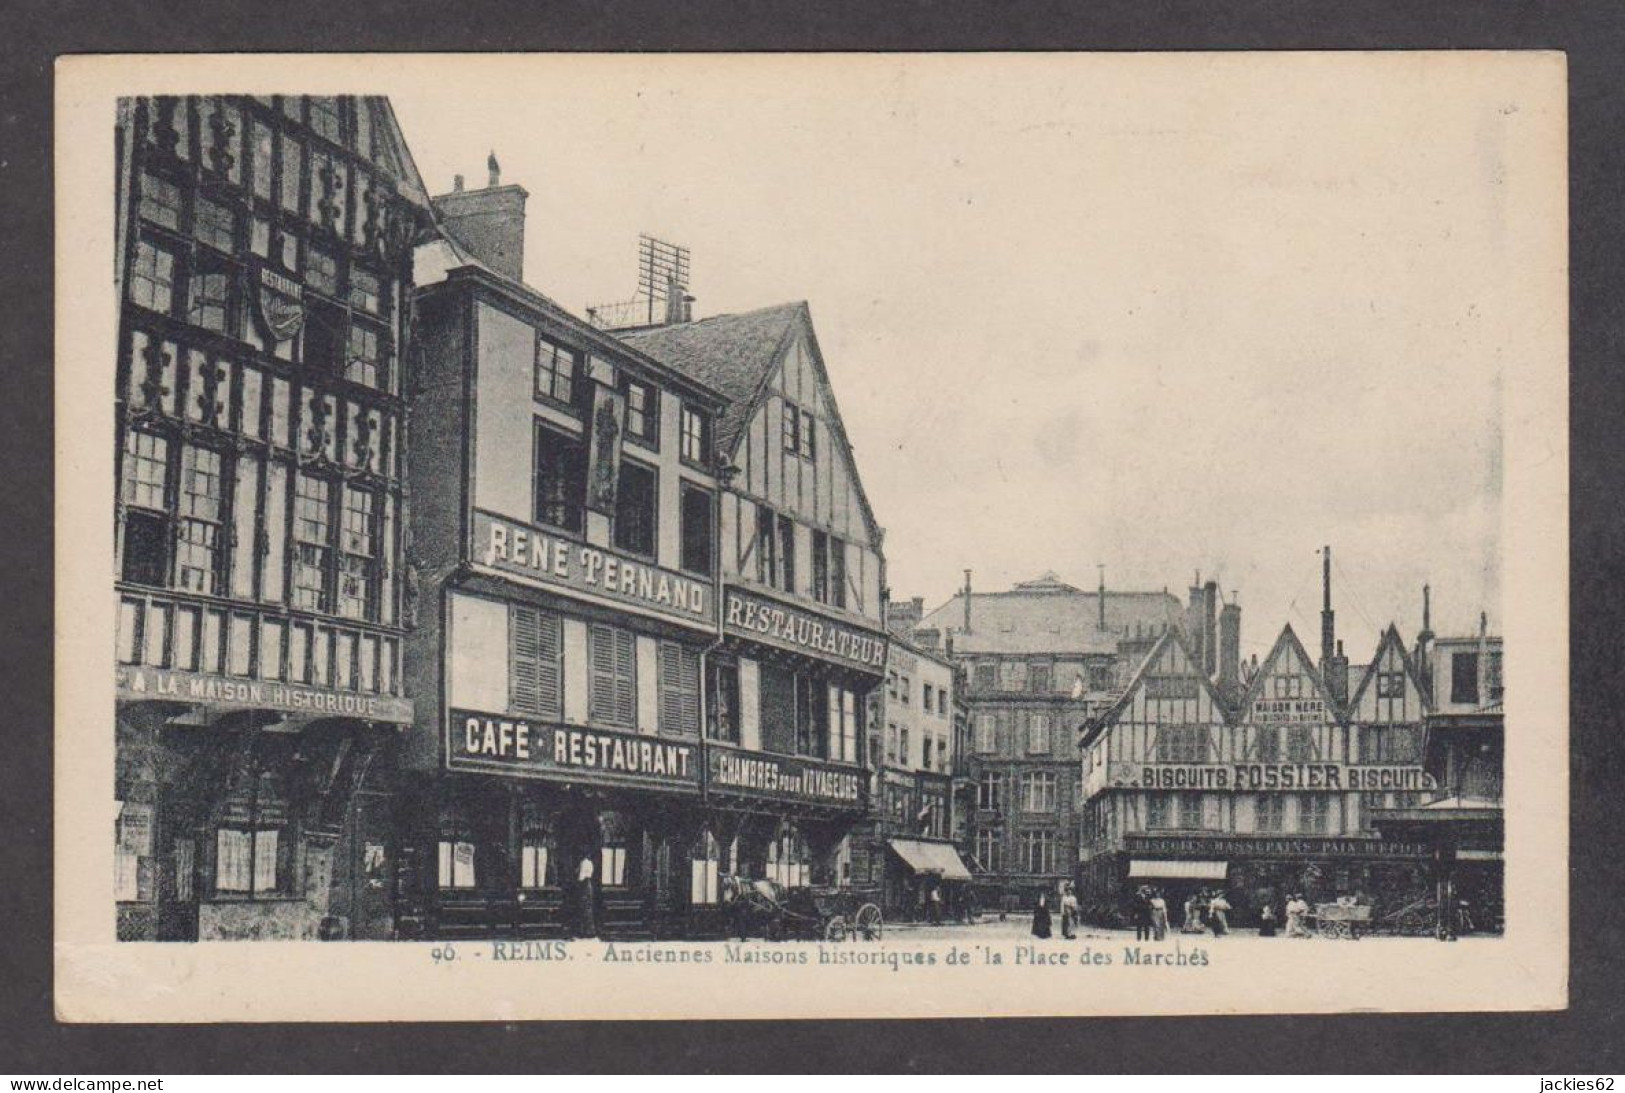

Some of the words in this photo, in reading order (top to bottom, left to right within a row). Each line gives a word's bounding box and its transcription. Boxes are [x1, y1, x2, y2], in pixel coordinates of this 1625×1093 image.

[580, 547, 703, 613] TERNAND
[728, 597, 884, 665] RESTAURATEUR
[132, 671, 146, 692] A
[158, 674, 179, 695] LA
[190, 678, 262, 704] MAISON
[273, 689, 376, 715] HISTORIQUE
[554, 729, 690, 777] RESTAURANT
[719, 755, 779, 790] CHAMBRES
[802, 767, 858, 799] VOYAGEURS
[1142, 767, 1227, 788] BISCUITS
[1234, 765, 1341, 789] FOSSIER
[1348, 767, 1432, 788] BISCUITS
[492, 942, 574, 961] REIMS.
[603, 943, 713, 962] Anciennes
[724, 944, 808, 964] Maisons
[818, 944, 937, 971] historiques
[945, 946, 970, 965] de
[985, 946, 1001, 965] la
[1014, 945, 1070, 966] Place
[1080, 945, 1113, 966] des
[1123, 944, 1210, 967] Marchés
